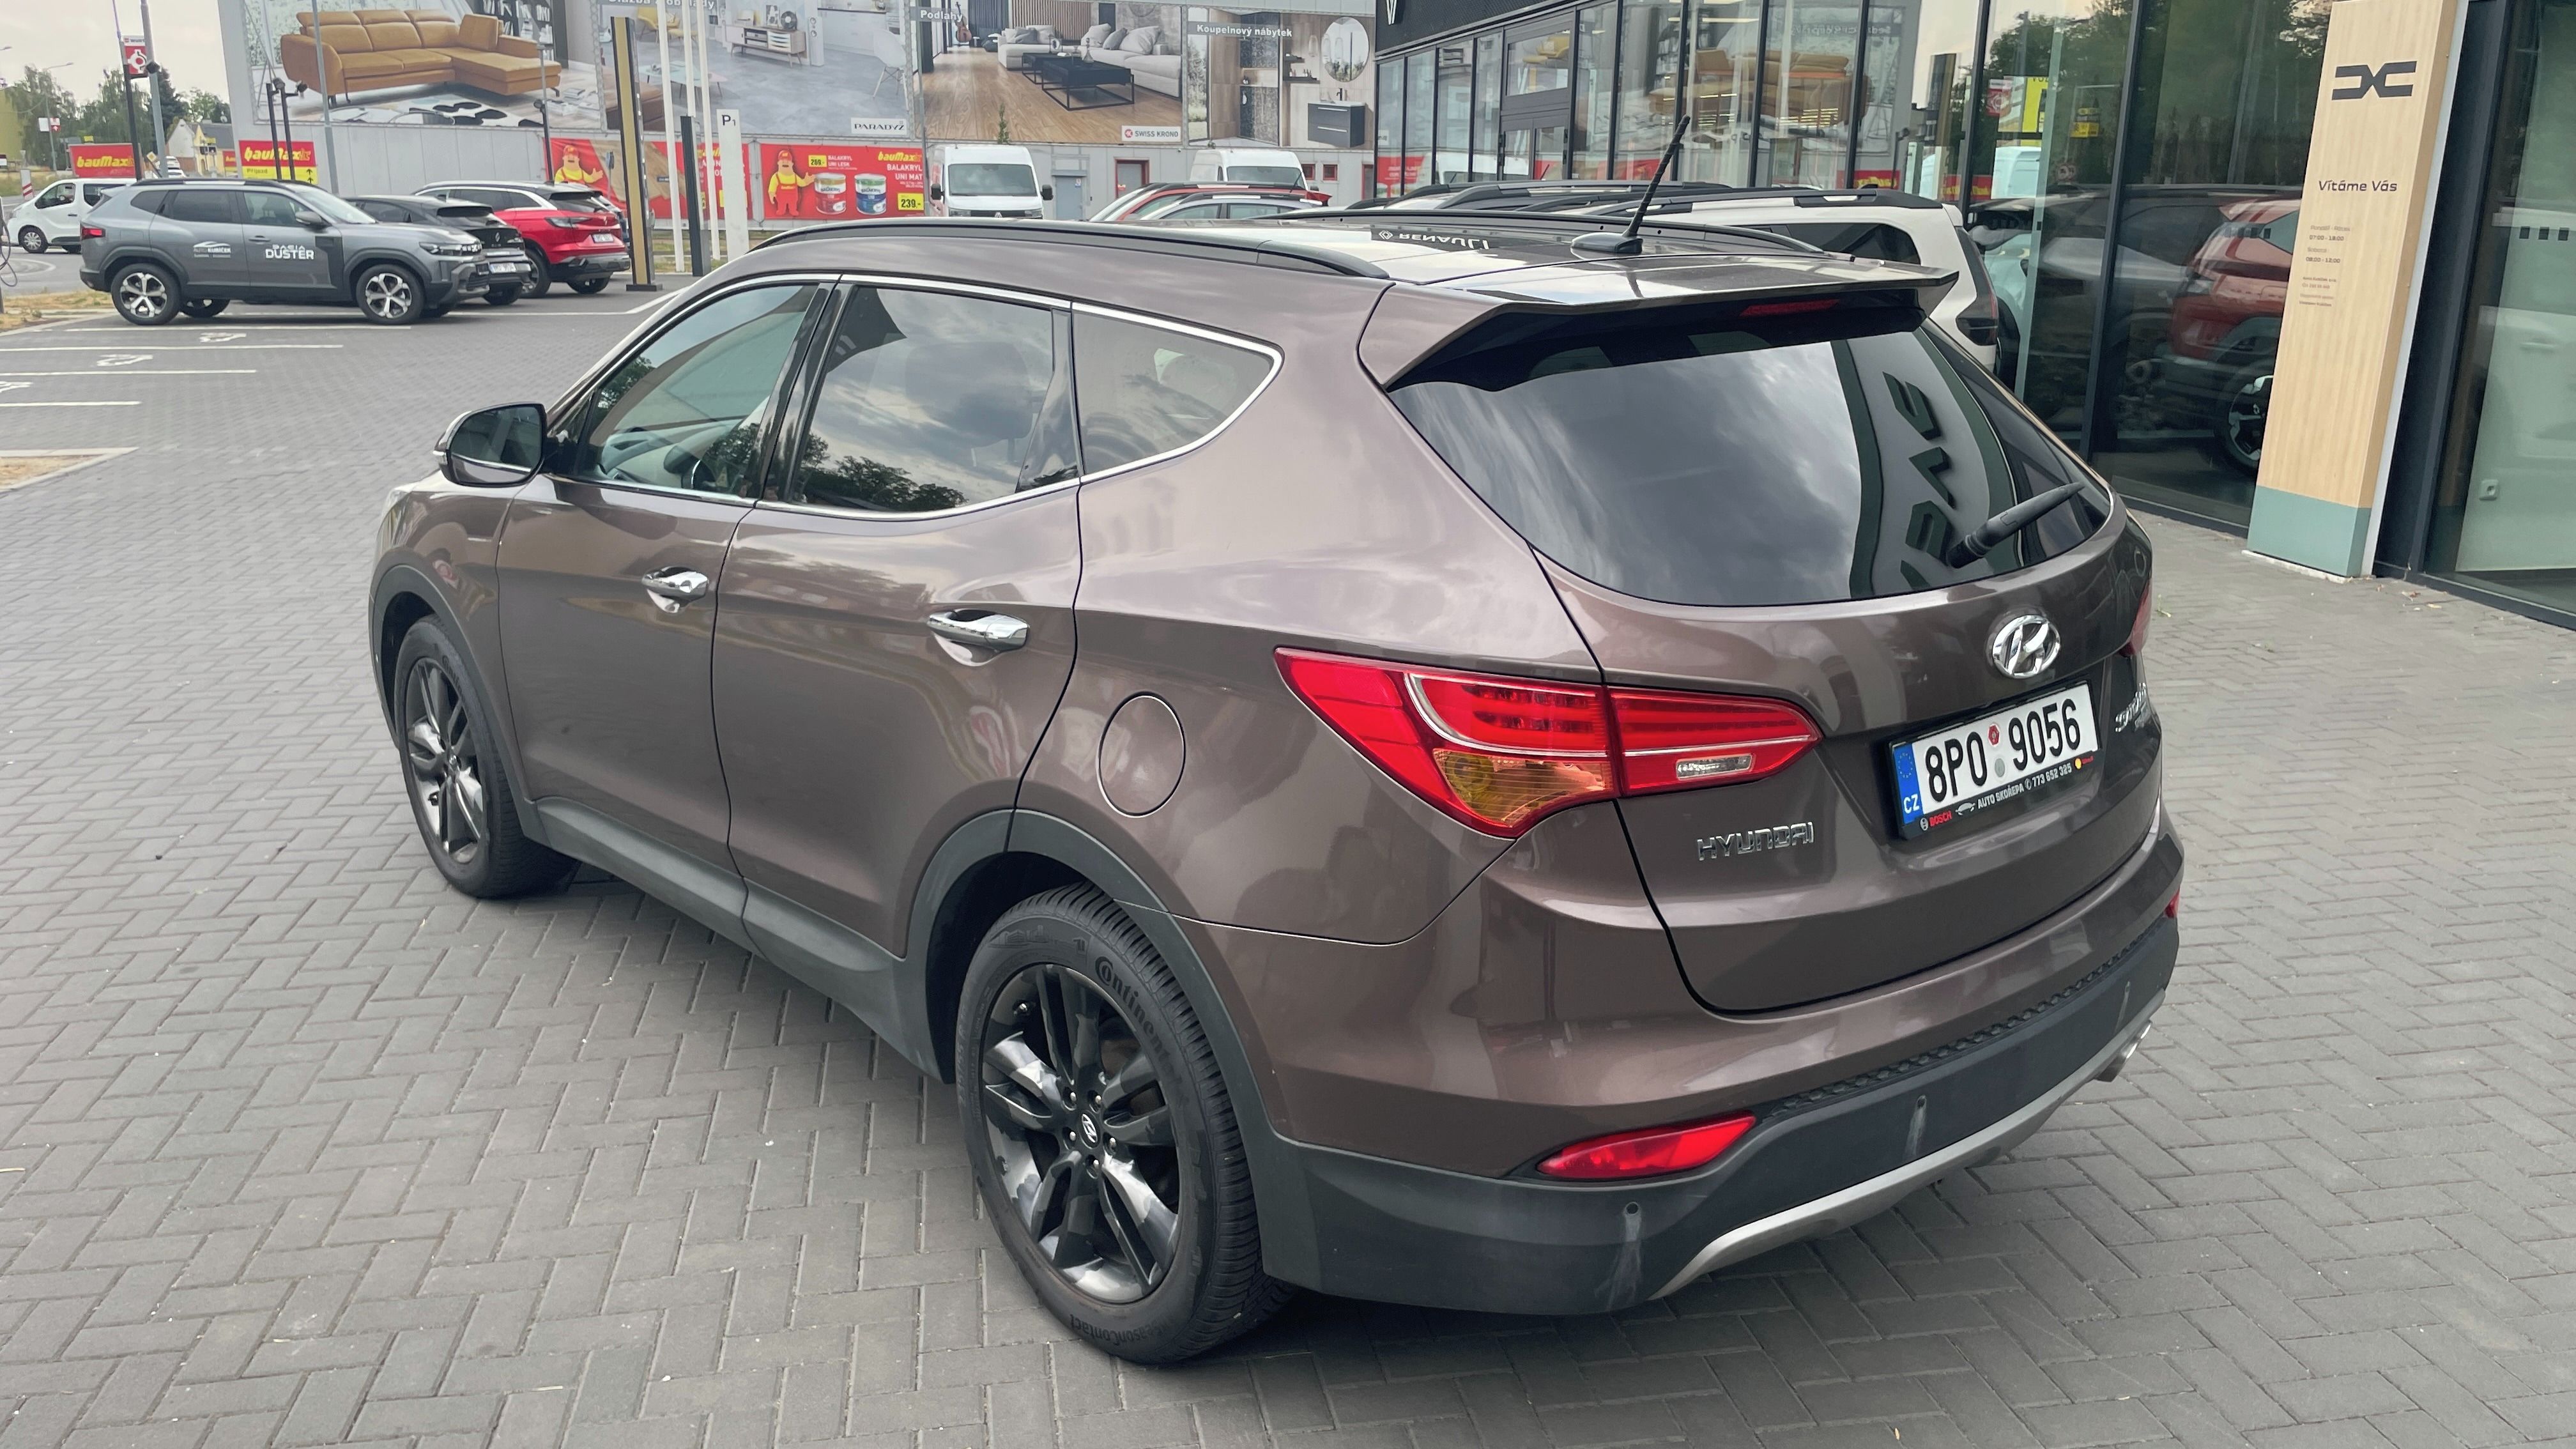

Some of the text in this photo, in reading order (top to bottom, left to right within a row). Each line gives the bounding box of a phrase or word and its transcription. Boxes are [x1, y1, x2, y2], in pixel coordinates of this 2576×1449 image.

[920, 10, 963, 22] Podlahy
[1197, 24, 1292, 38] Koupelnový nábytek
[886, 164, 923, 172] BALAKRYL
[2319, 180, 2398, 192] Vítáme Vás
[265, 249, 314, 260] DUSTER
[2008, 698, 2082, 771] 9056
[1977, 762, 2073, 809] AUTO SKOŘEPA 773 652 325
[1903, 793, 1920, 815] CZ
[1929, 809, 1952, 827] BOSCH
[1697, 822, 1814, 861] HYUNDAI
